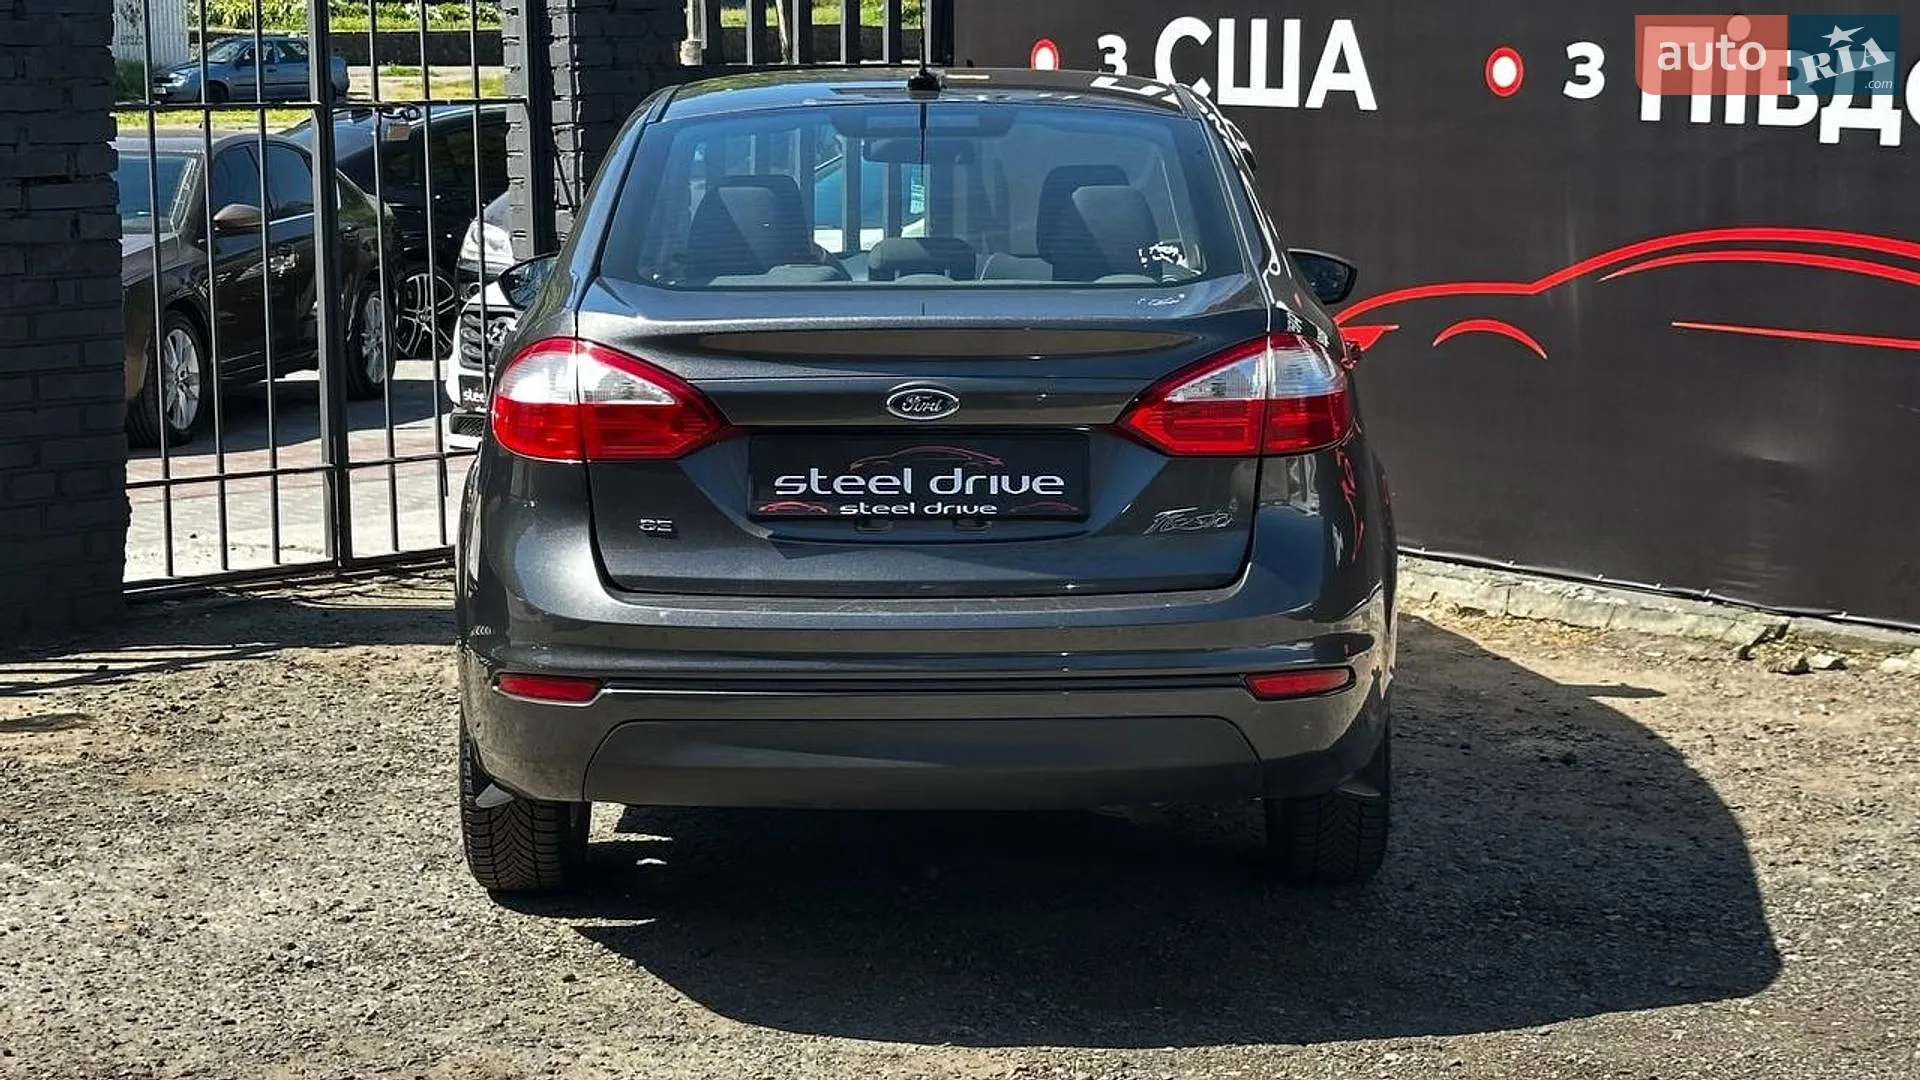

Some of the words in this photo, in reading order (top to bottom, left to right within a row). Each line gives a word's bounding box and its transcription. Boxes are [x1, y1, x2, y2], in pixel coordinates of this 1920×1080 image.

[1154, 16, 1378, 111] США
[1640, 14, 1920, 147] Півд
[901, 394, 943, 413] Ford
[774, 467, 912, 496] steel
[929, 467, 1065, 496] drive
[839, 502, 915, 515] steel
[923, 502, 998, 515] drive
[639, 518, 673, 532] SE
